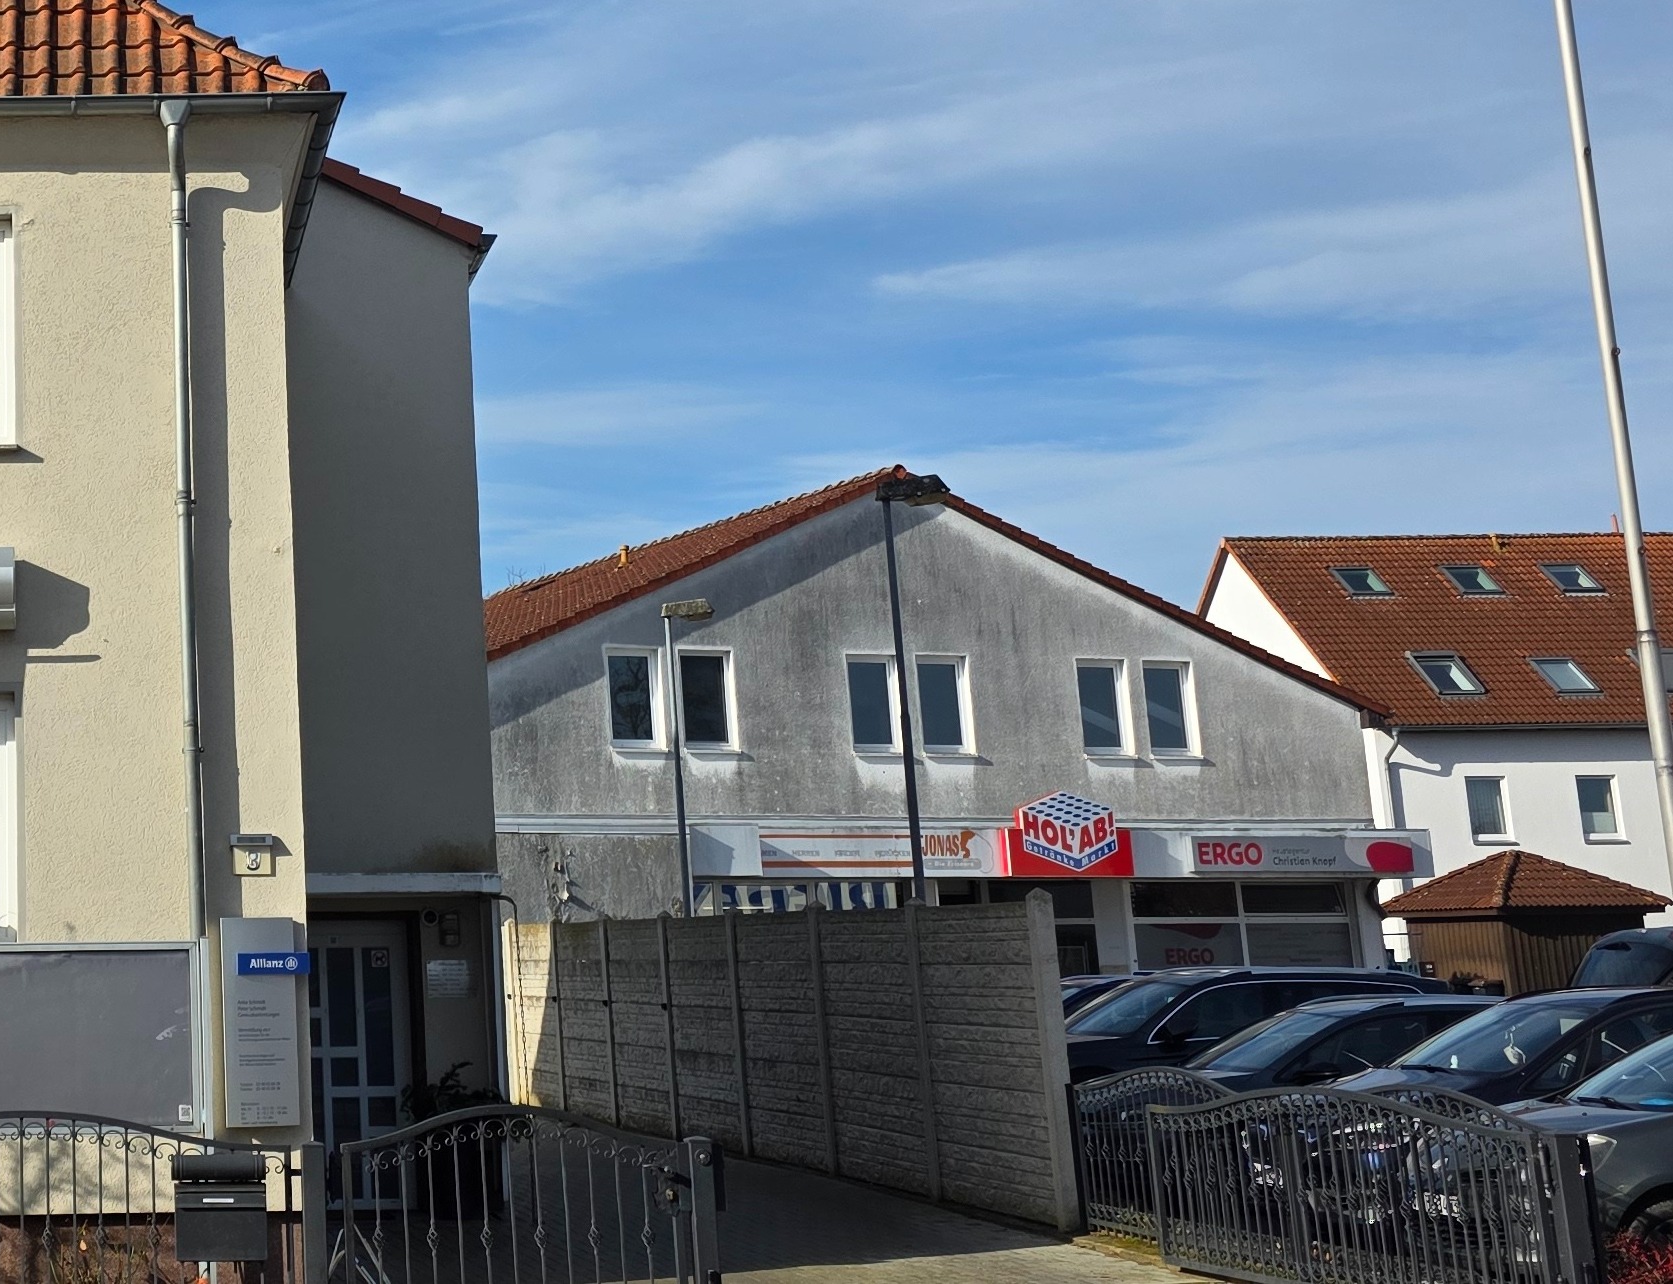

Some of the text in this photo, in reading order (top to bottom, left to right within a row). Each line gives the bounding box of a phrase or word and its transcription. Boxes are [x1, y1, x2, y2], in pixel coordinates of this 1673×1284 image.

[921, 834, 960, 857] JONAS
[1026, 841, 1115, 867] Getränke Markt
[1197, 842, 1263, 866] ERGO
[1273, 856, 1336, 868] Christian Knopf
[249, 958, 284, 969] Allianz
[1165, 948, 1215, 965] ERGO
